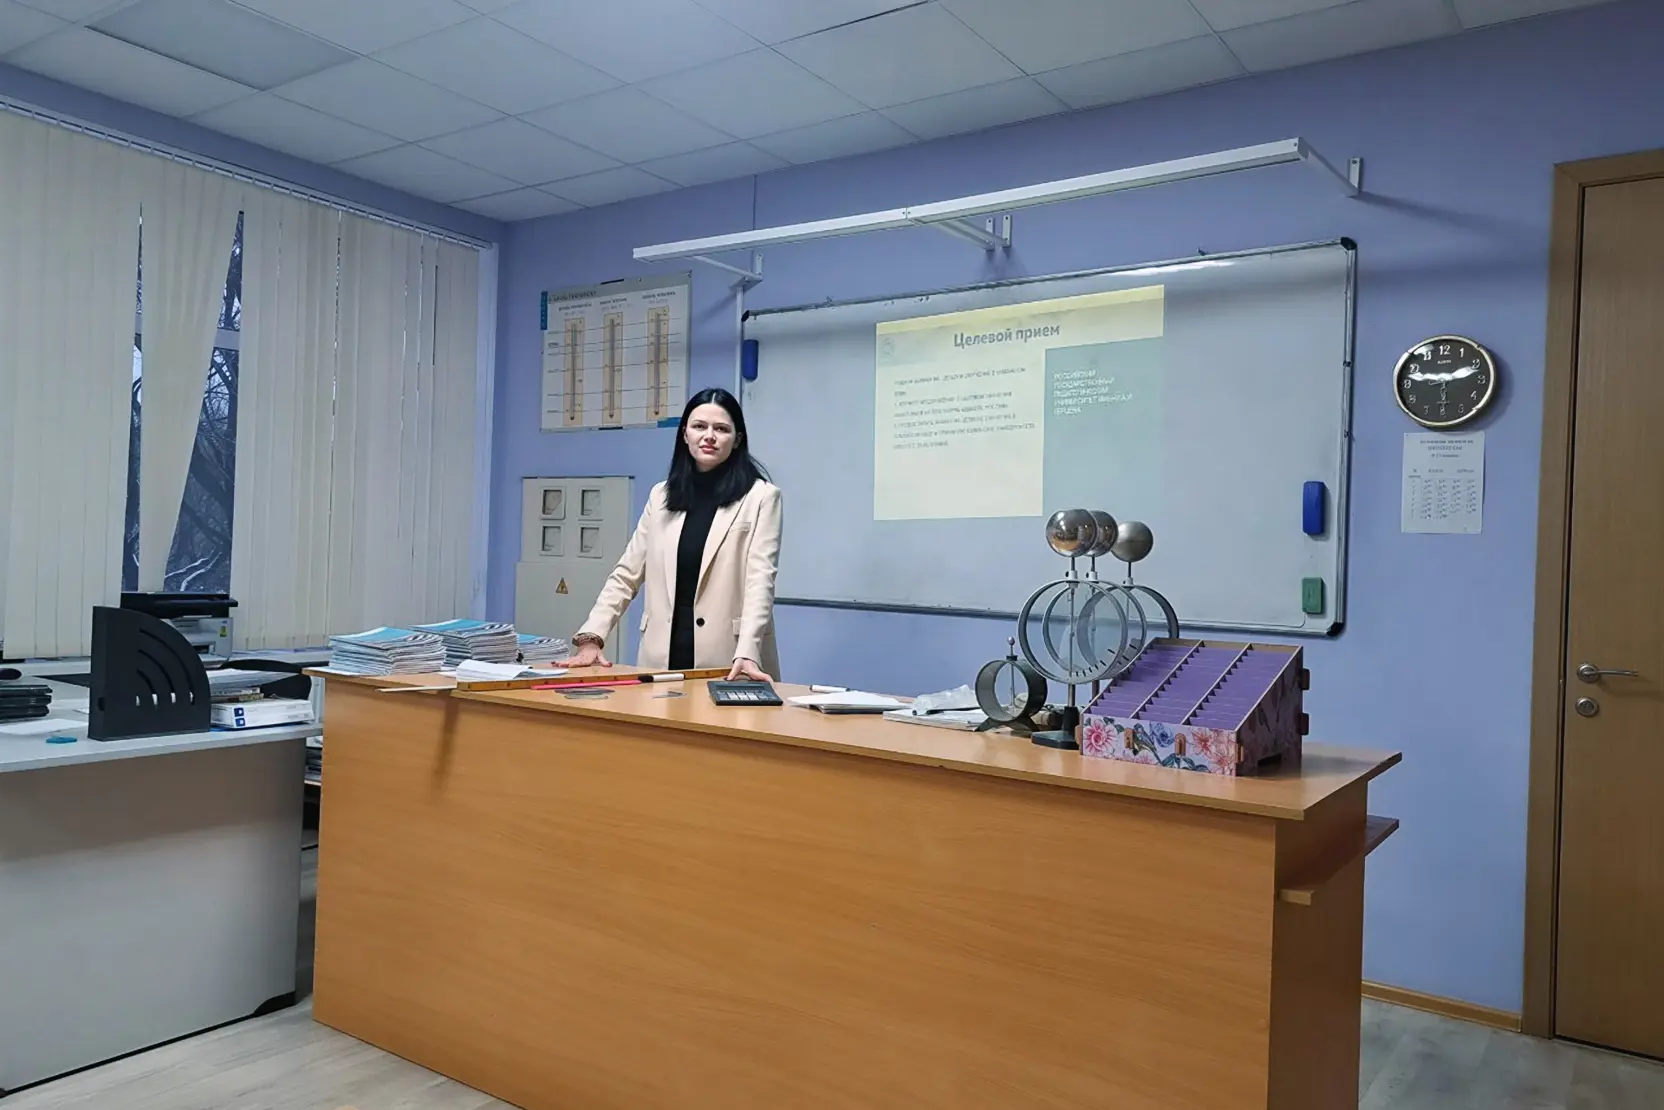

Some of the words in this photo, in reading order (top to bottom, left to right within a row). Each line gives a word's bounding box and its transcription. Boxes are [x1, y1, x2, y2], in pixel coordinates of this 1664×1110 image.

[954, 328, 1013, 349] Целевой
[1015, 325, 1060, 343] прием
[1439, 344, 1451, 356] 12
[1459, 347, 1465, 358] 1
